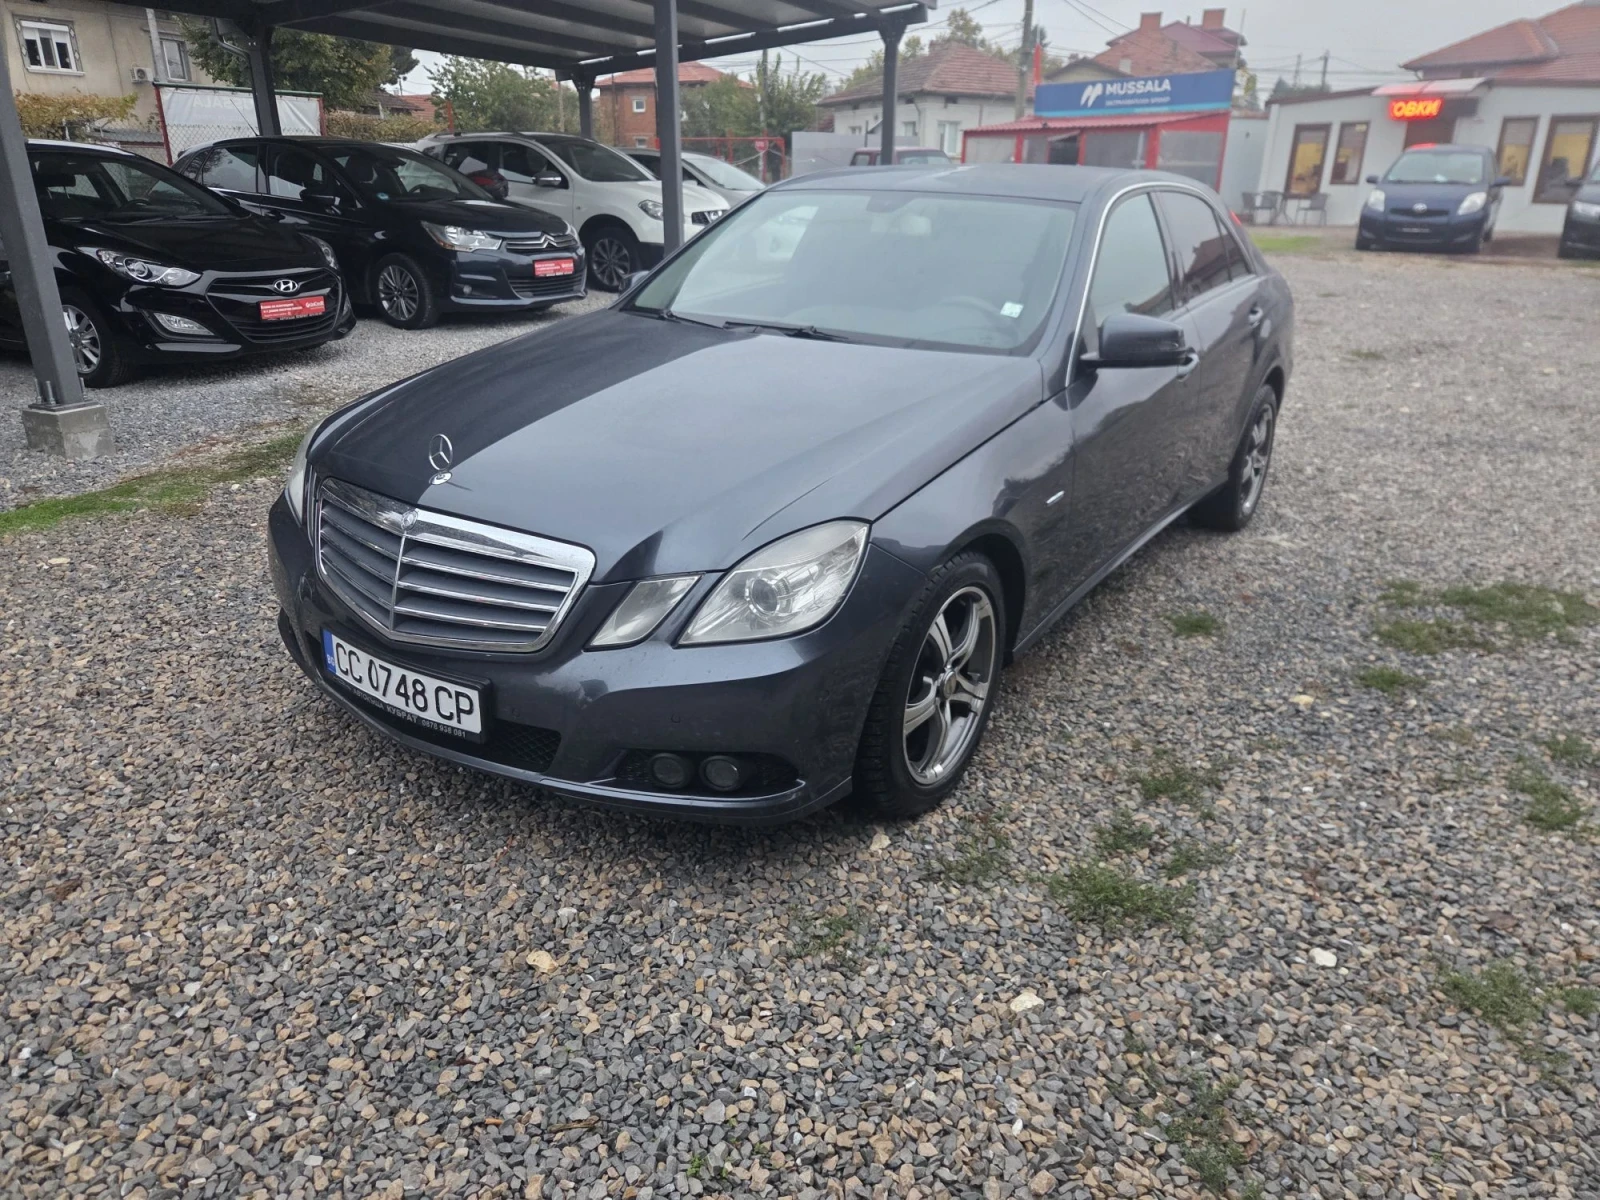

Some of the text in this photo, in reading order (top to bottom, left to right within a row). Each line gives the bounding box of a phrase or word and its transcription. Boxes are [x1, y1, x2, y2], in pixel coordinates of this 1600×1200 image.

[1105, 79, 1172, 96] MUSSALA
[326, 654, 336, 667] BG
[386, 705, 419, 724] КУБРАТ
